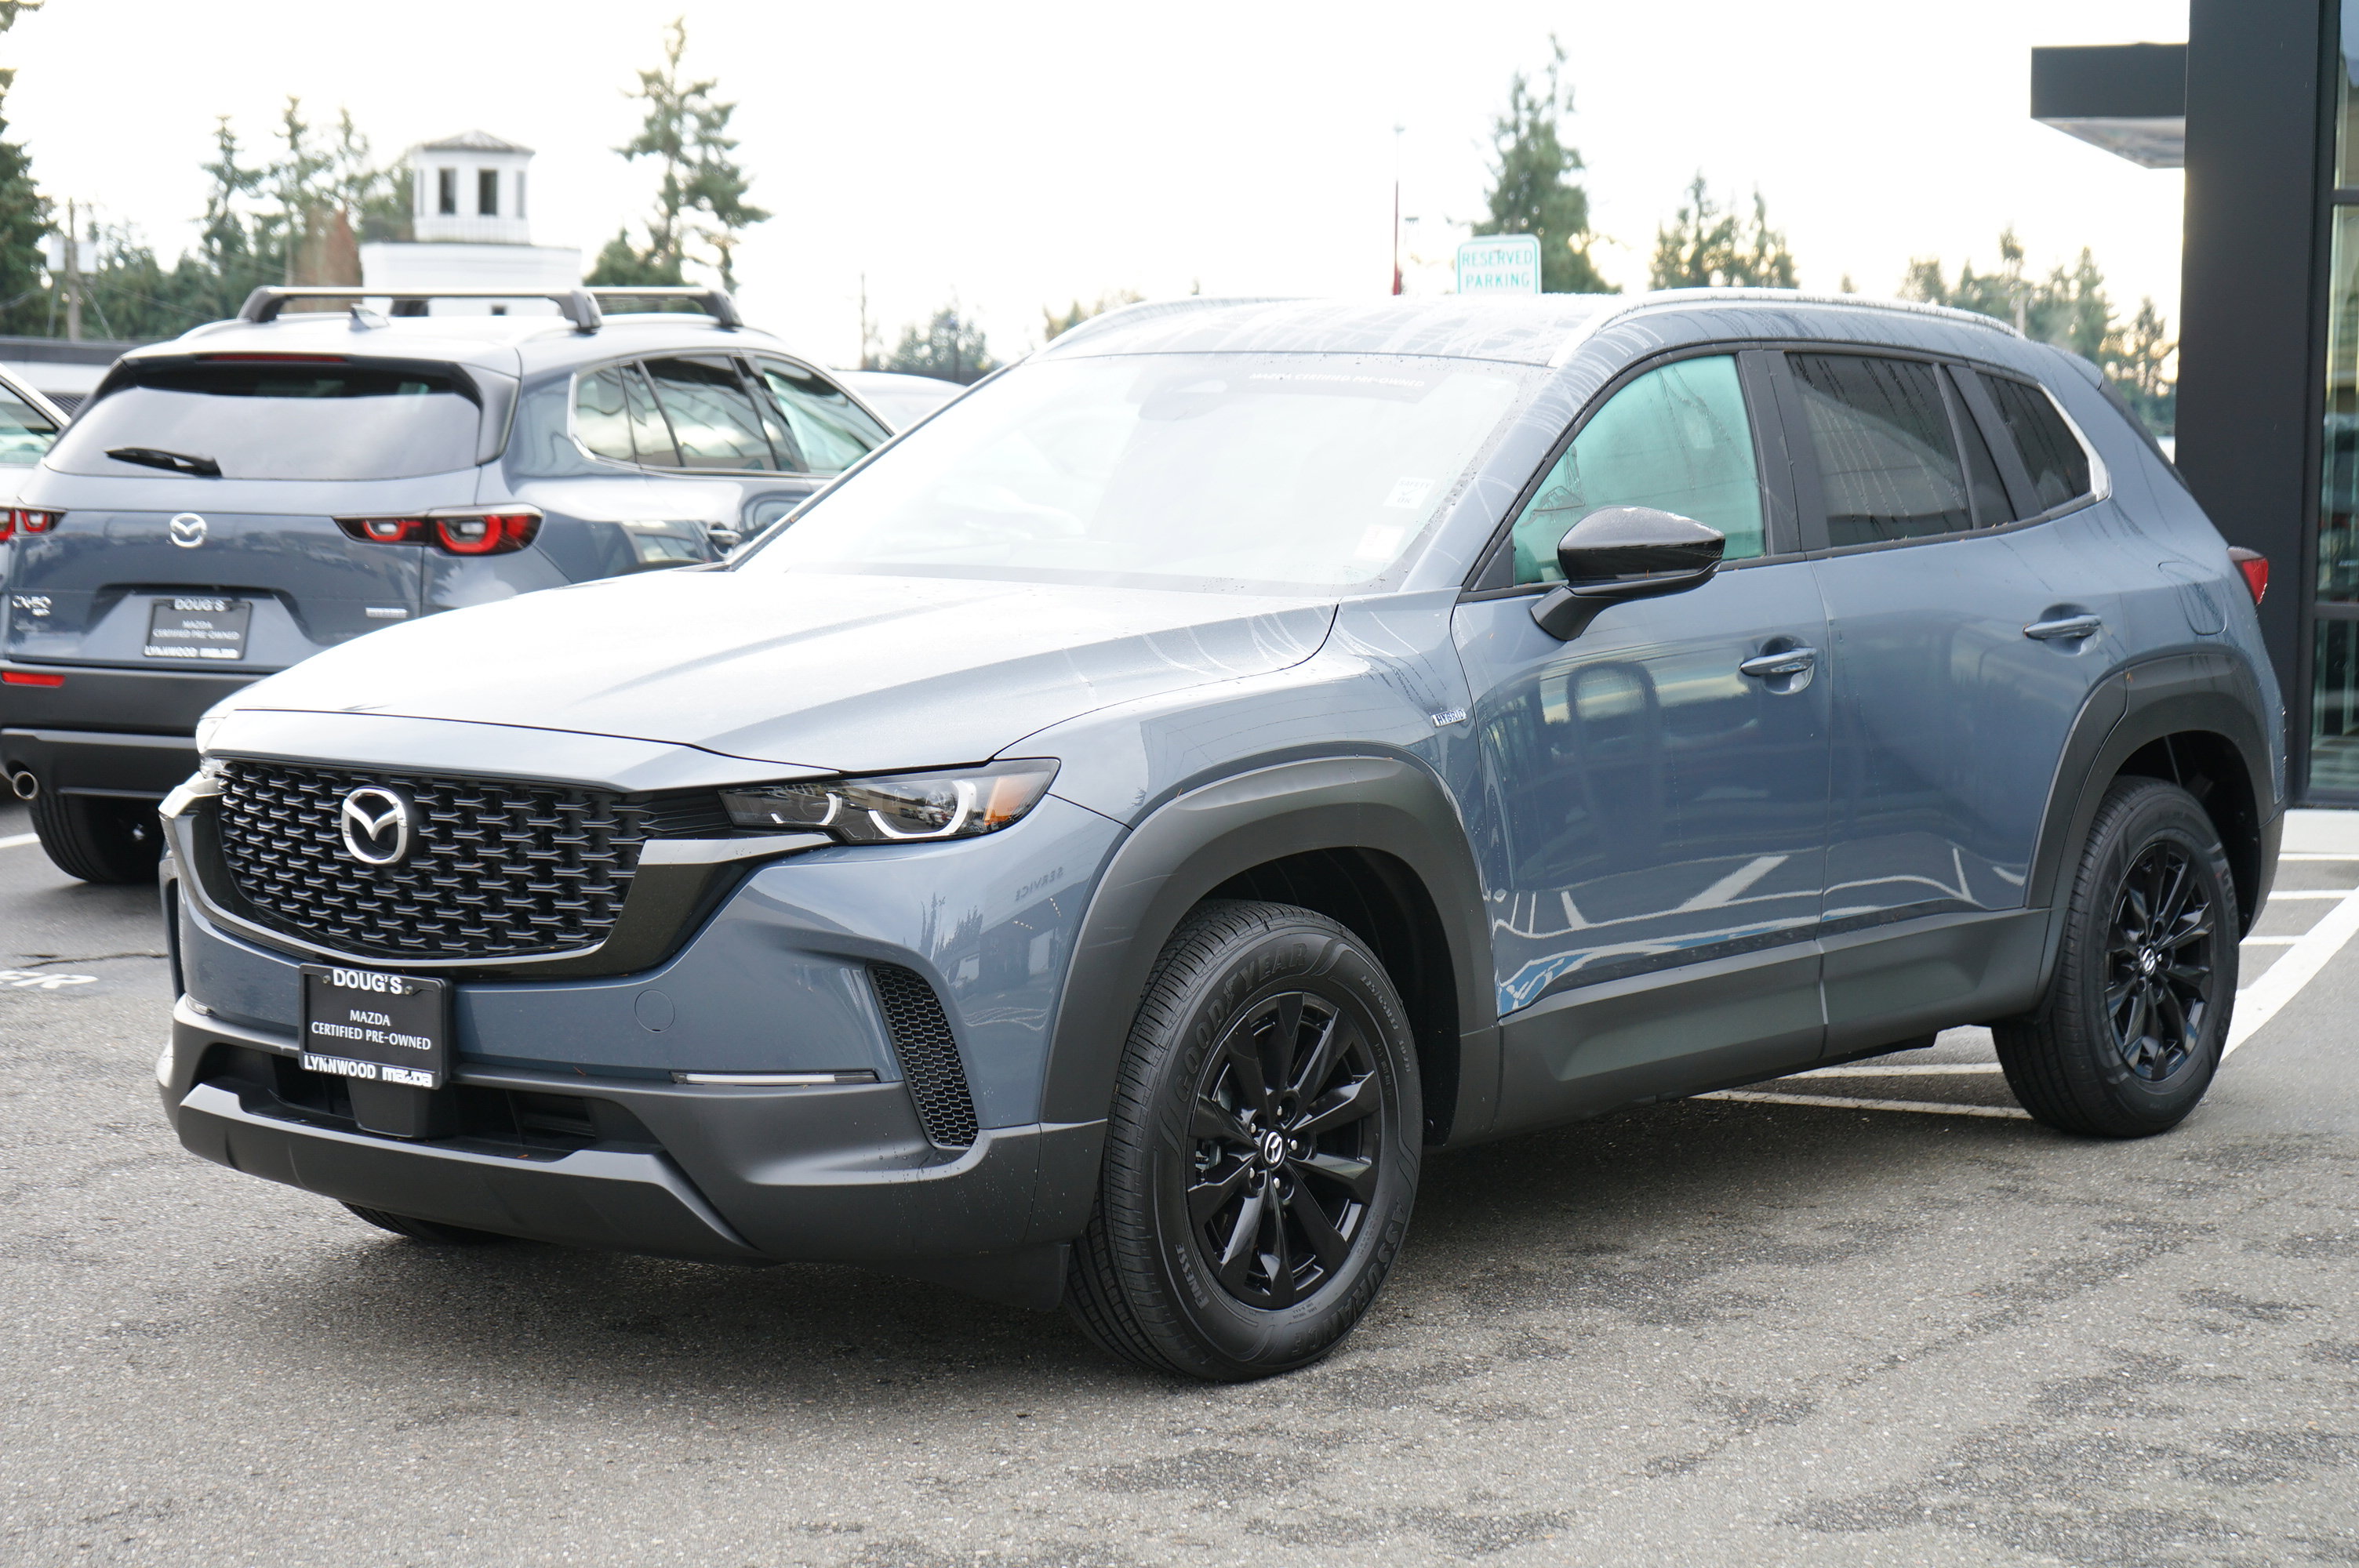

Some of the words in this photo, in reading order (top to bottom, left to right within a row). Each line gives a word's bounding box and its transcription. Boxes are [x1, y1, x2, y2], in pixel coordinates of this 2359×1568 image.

[1462, 250, 1532, 267] RESERVED
[1465, 272, 1531, 289] PARKING
[1295, 373, 1350, 382] CERTIFIED
[1353, 376, 1426, 387] PRE-OWNED
[174, 598, 226, 612] DOUG'S
[1435, 710, 1465, 726] HYBRID
[333, 969, 402, 994] DOUG'S
[349, 1010, 391, 1027] MAZDA
[1174, 942, 1308, 1105] GOODYEAR
[311, 1022, 362, 1040] CERTIFIED
[365, 1029, 431, 1051] PRE-OWNED
[304, 1054, 376, 1080] LYNNWOOD
[1292, 1196, 1405, 1355] ASSURANCE
